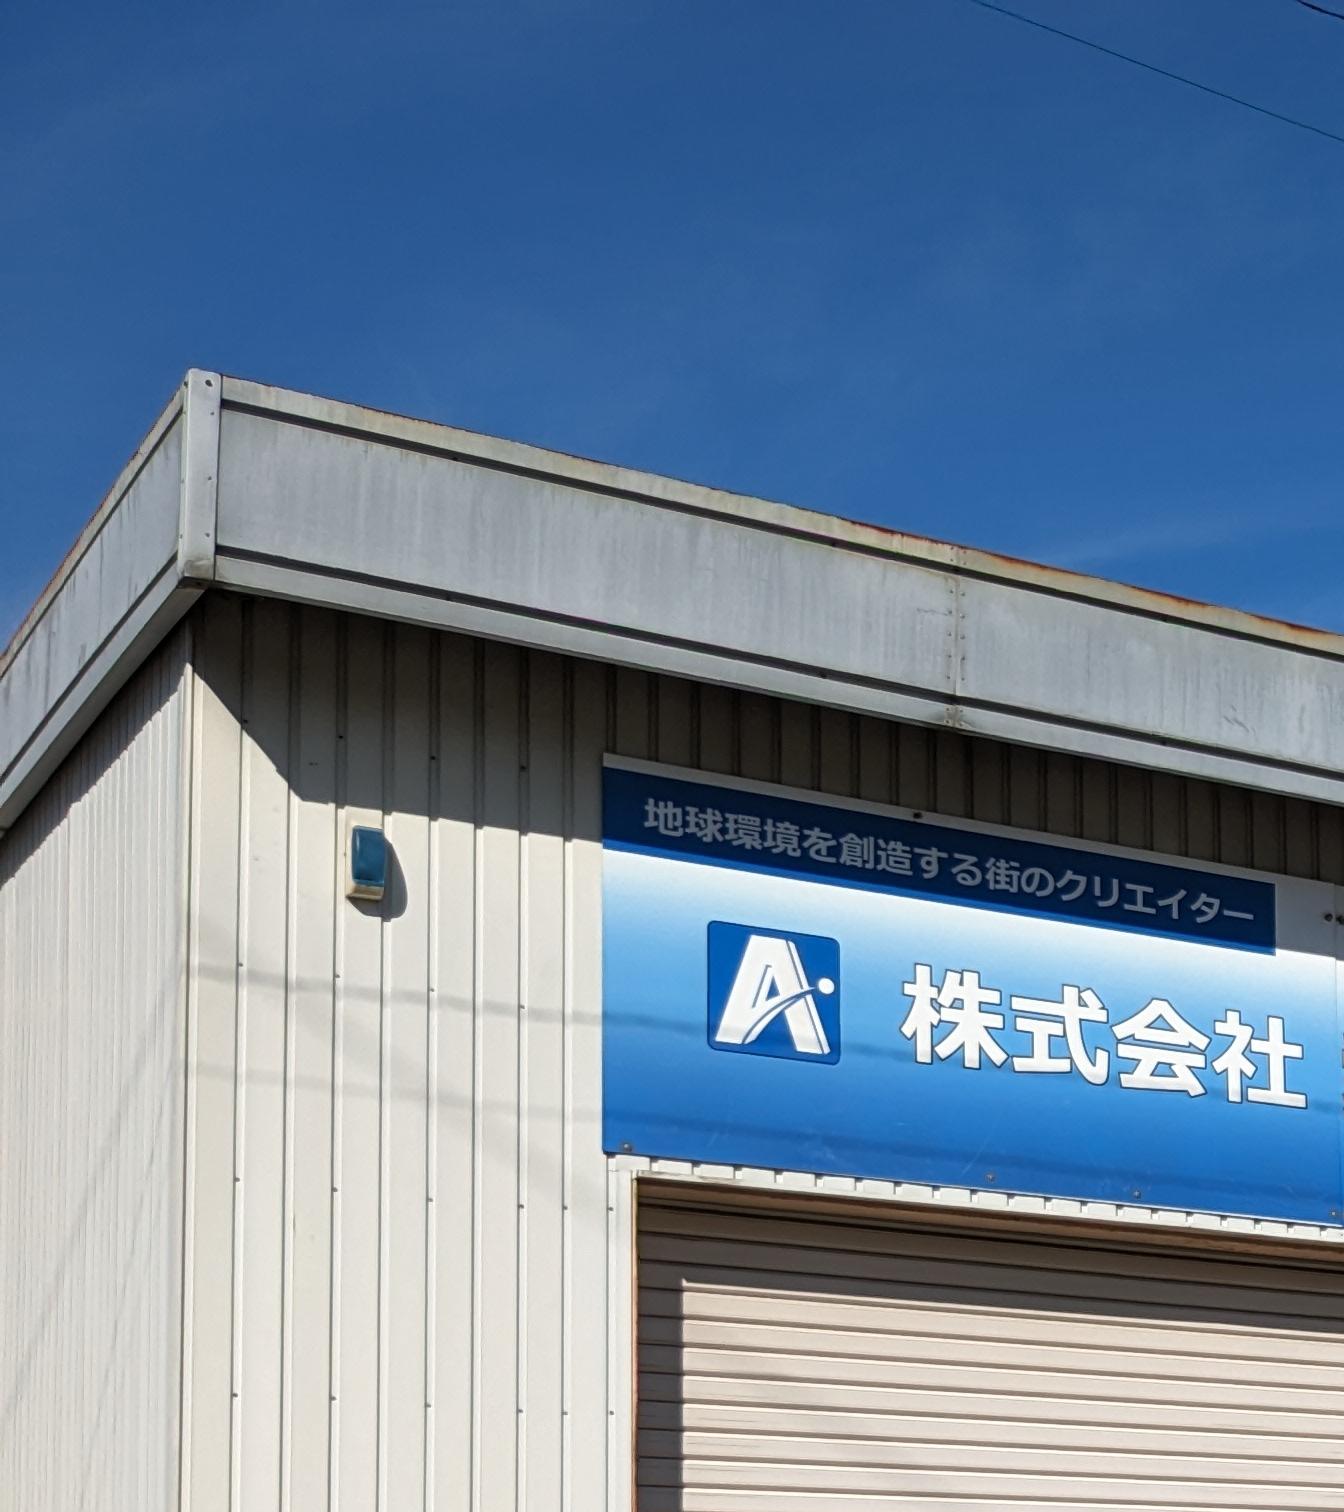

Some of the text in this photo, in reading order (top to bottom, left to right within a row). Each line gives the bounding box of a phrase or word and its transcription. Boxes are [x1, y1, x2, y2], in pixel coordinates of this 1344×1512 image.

[643, 797, 1255, 925] 地球環境を創造する街のクリエイター
[900, 962, 1308, 1110] 株式会社
